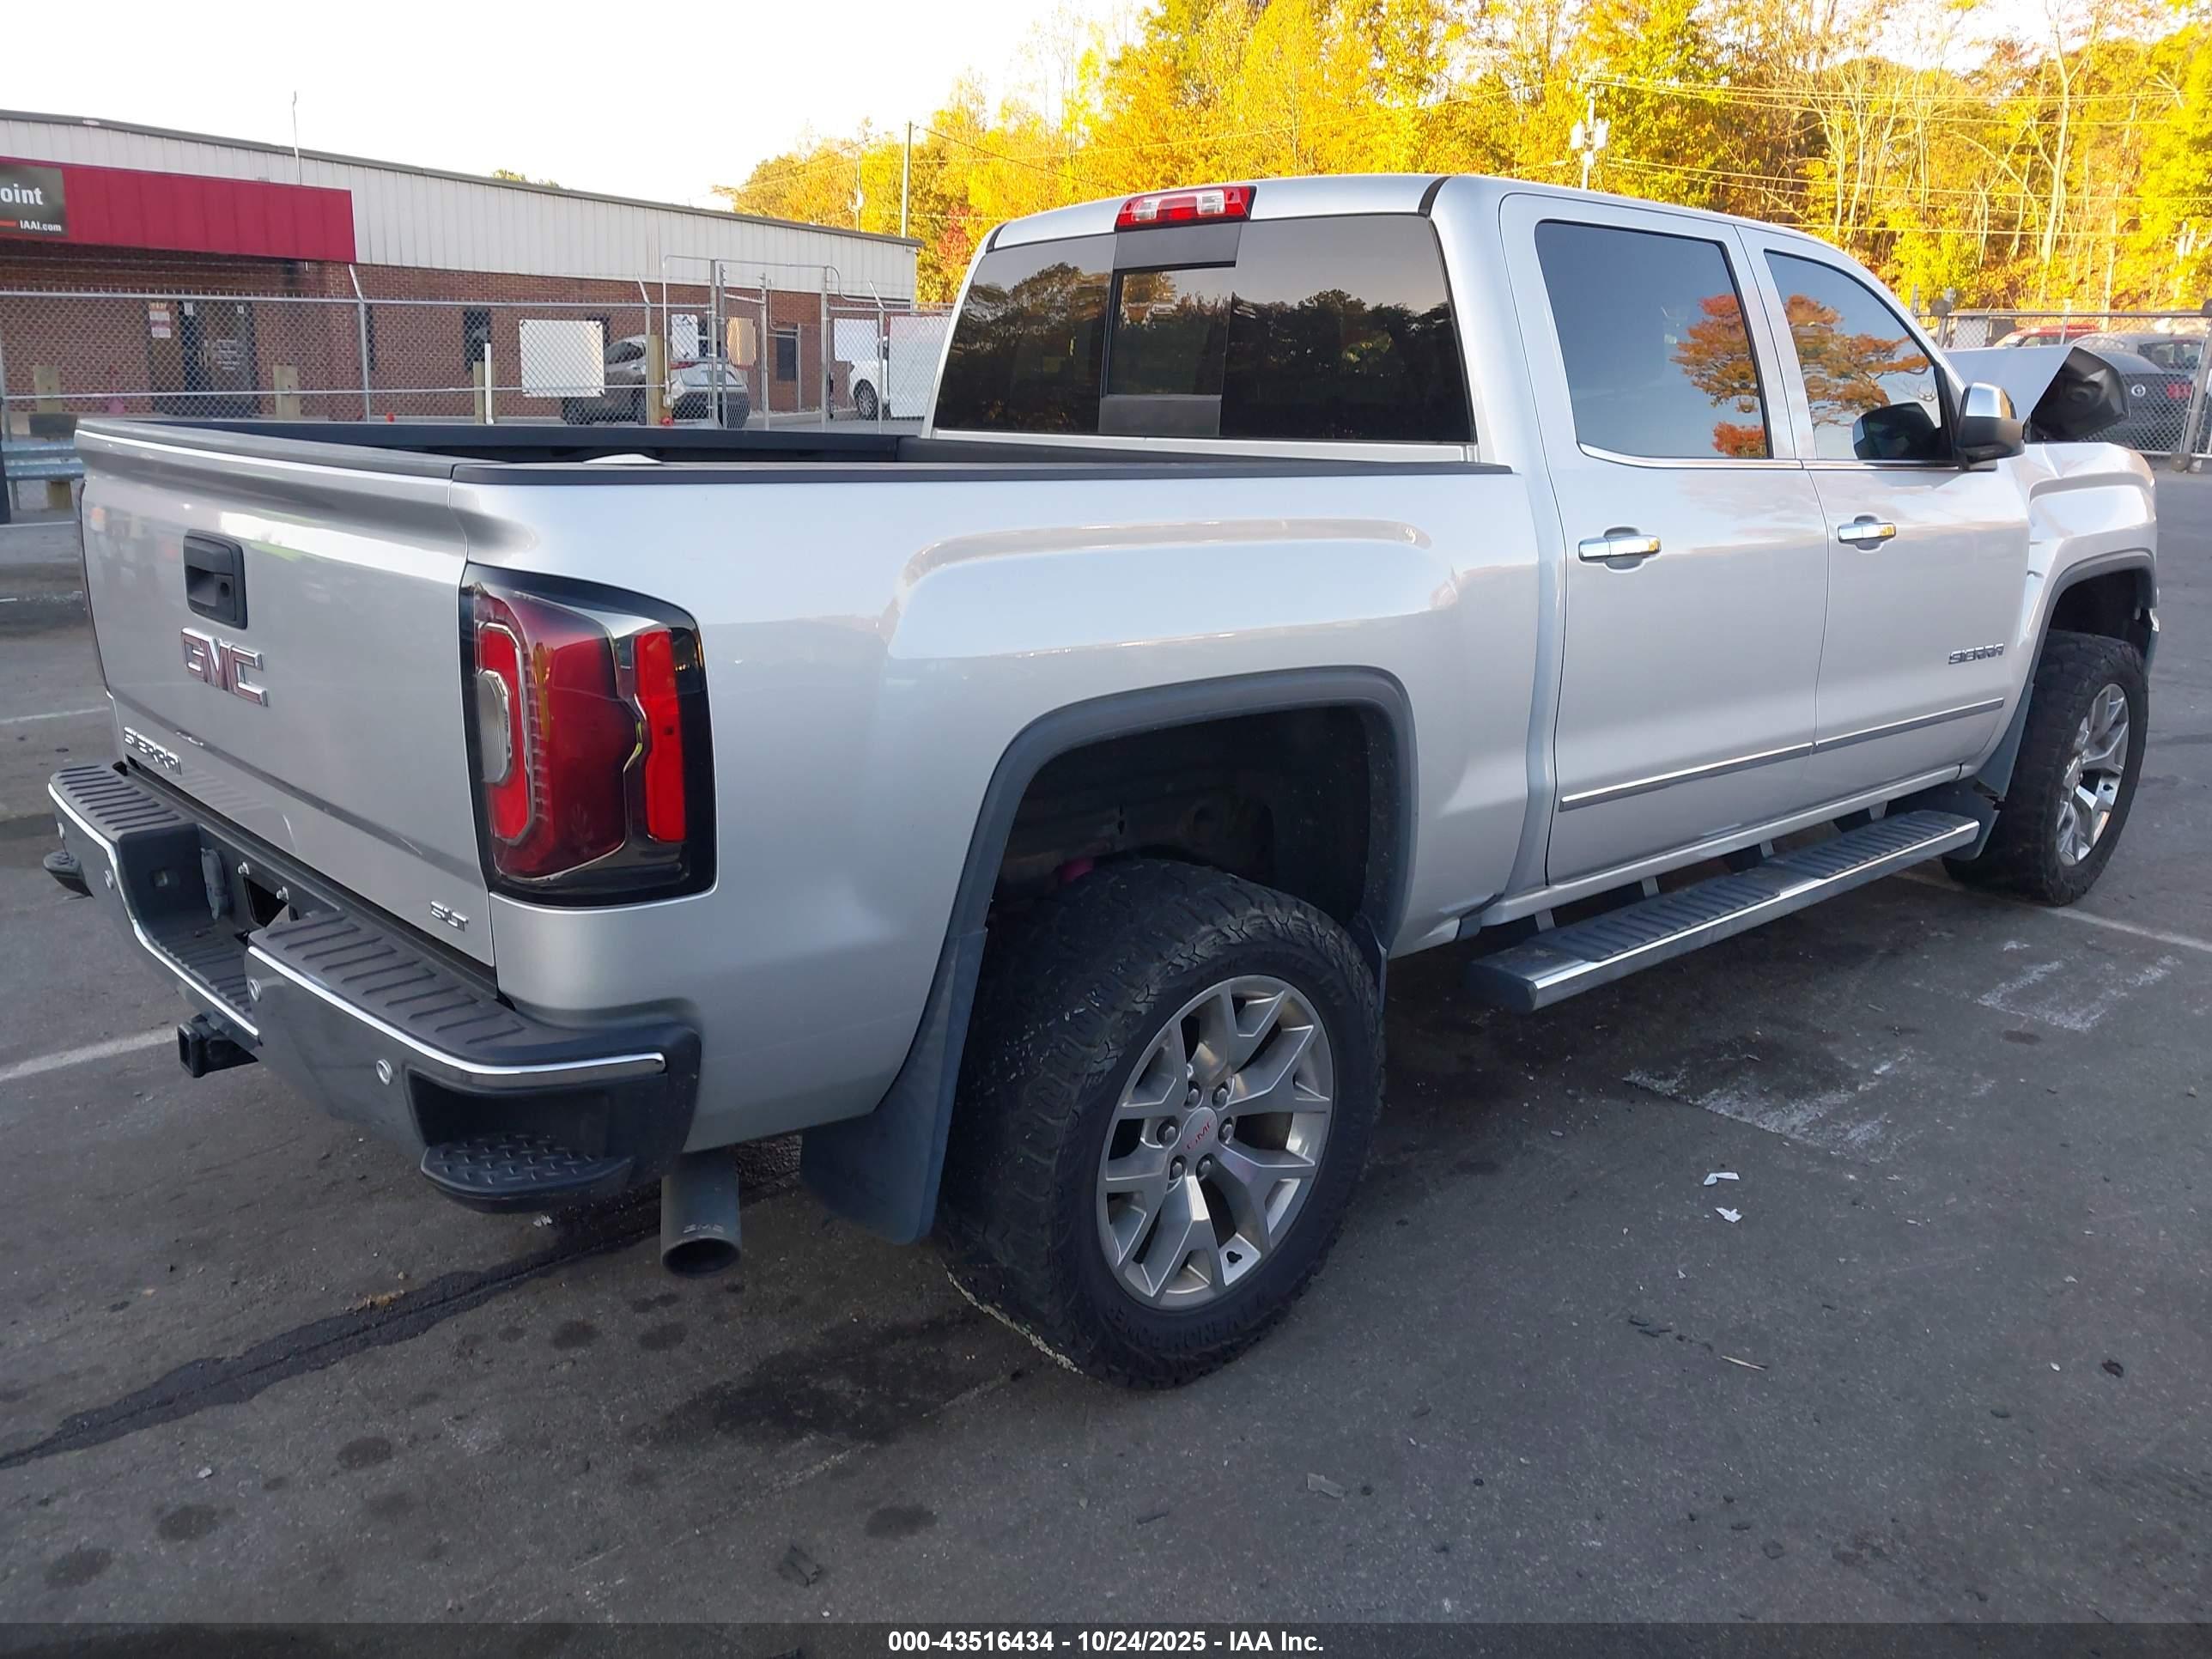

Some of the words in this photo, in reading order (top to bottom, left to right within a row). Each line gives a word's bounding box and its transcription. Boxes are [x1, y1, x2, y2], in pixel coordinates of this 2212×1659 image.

[20, 220, 62, 232] IAAI.com
[181, 628, 269, 707] GMC
[1948, 643, 2004, 665] SIERRA
[124, 726, 183, 775] SIERRA
[430, 901, 469, 932] SLT
